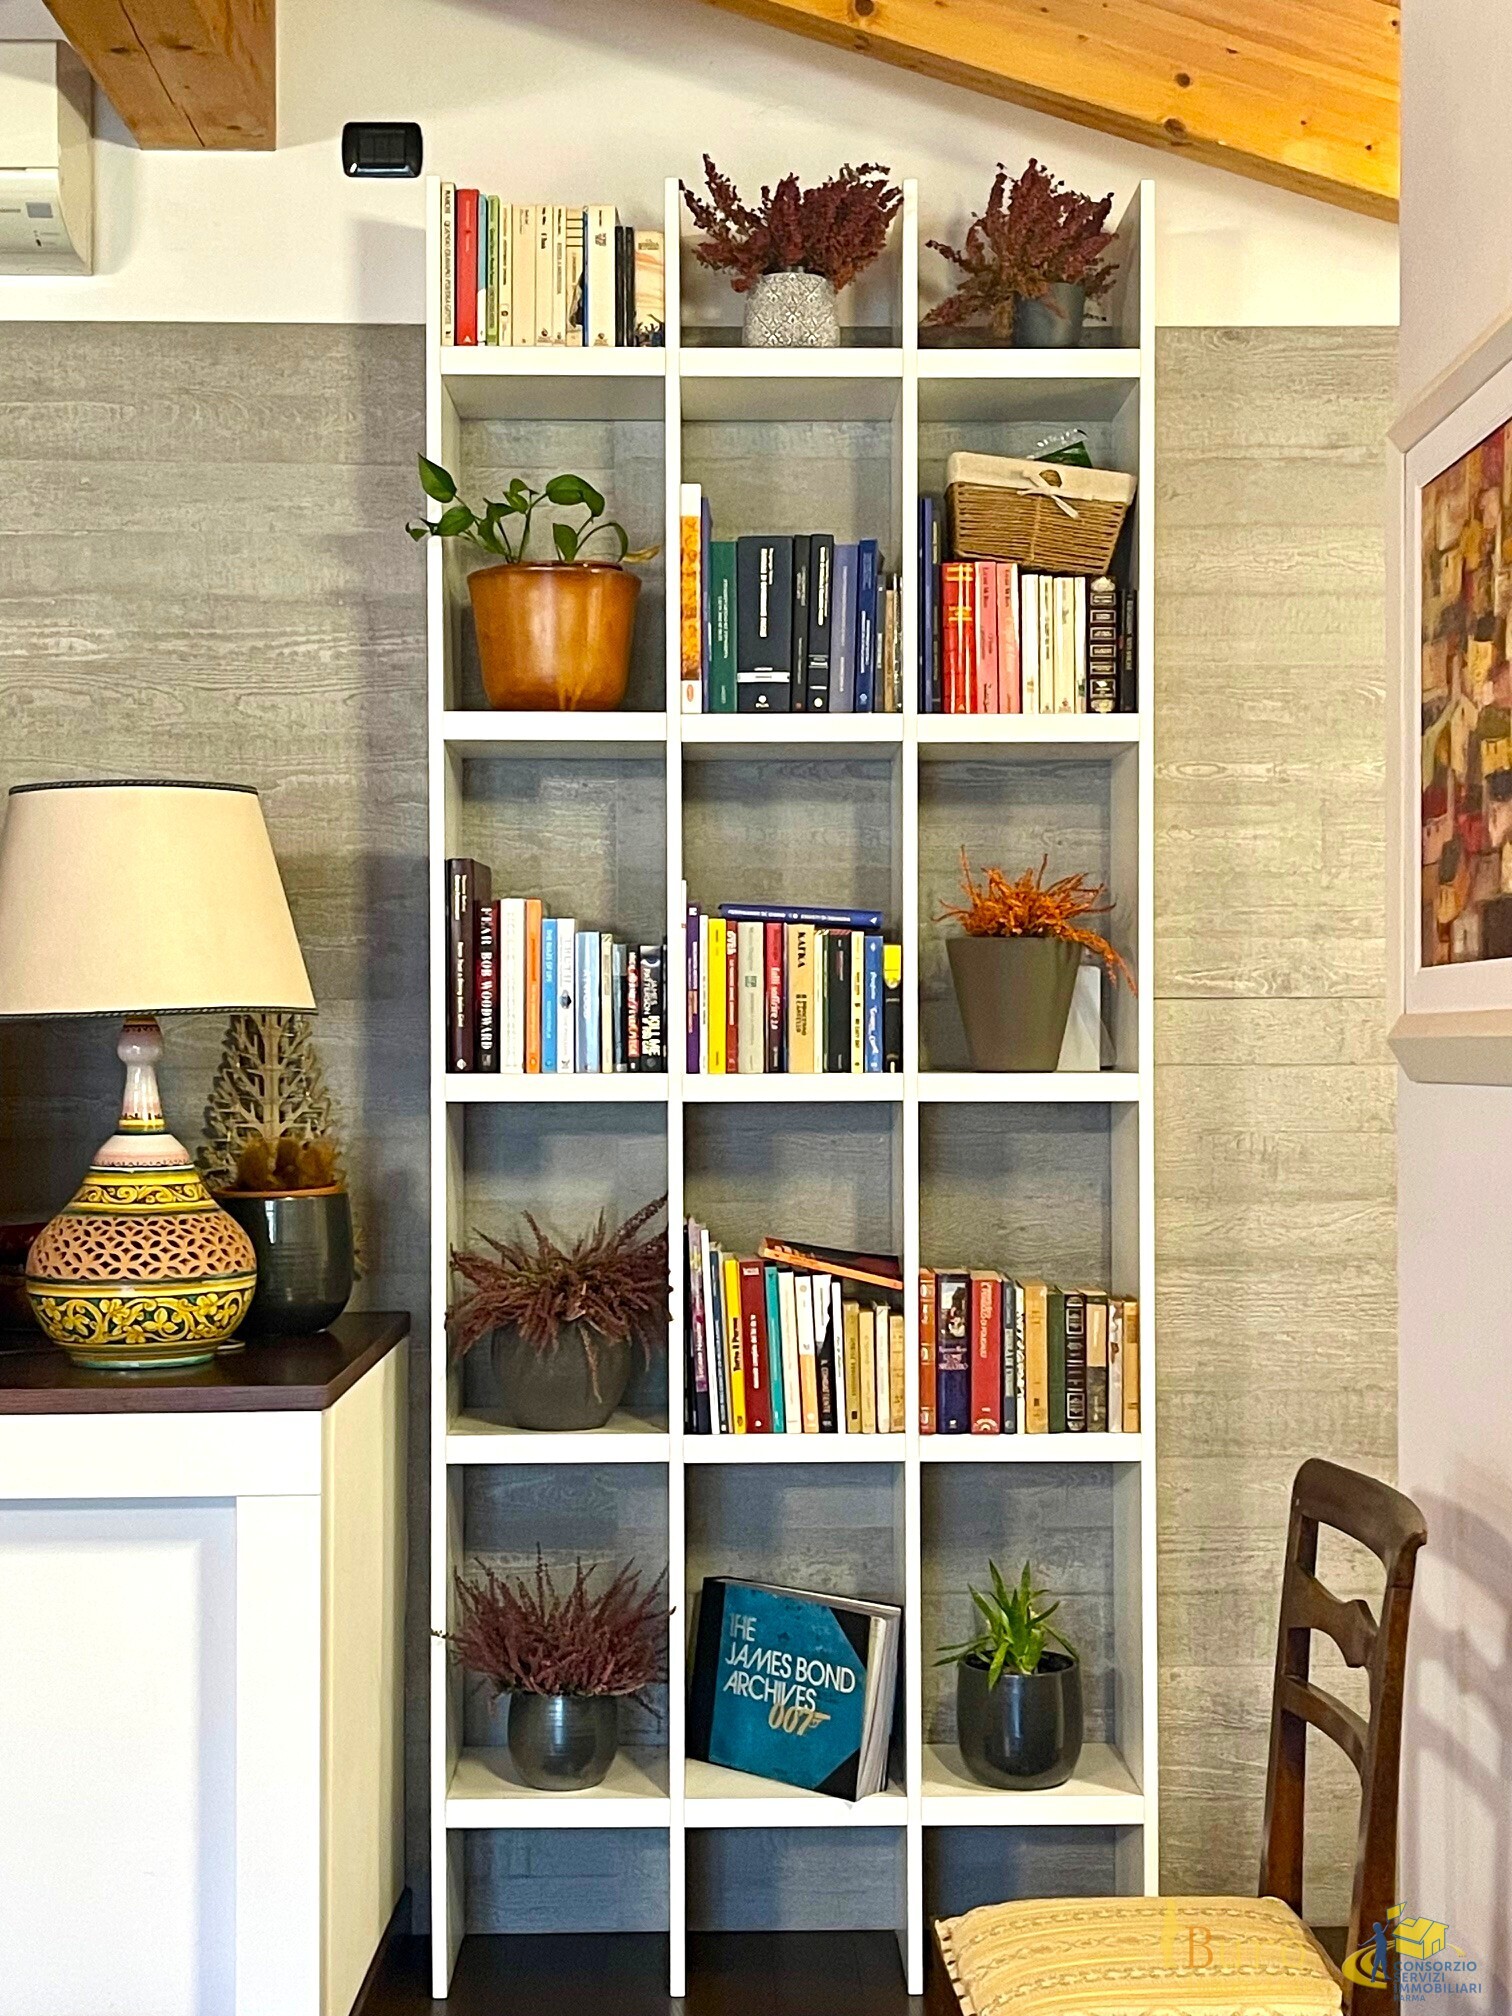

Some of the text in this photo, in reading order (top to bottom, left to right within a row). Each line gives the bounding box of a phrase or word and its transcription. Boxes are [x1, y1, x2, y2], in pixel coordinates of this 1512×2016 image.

[797, 931, 806, 968] KAFKA
[480, 907, 493, 1050] FEAR BOB WOODWARD
[643, 968, 651, 1015] PATTERSON
[649, 979, 659, 1005] JAMES
[729, 1612, 757, 1641] THE
[725, 1642, 856, 1694] JAMES BOND
[723, 1671, 817, 1711] ARCHIVES
[768, 1704, 816, 1736] 007
